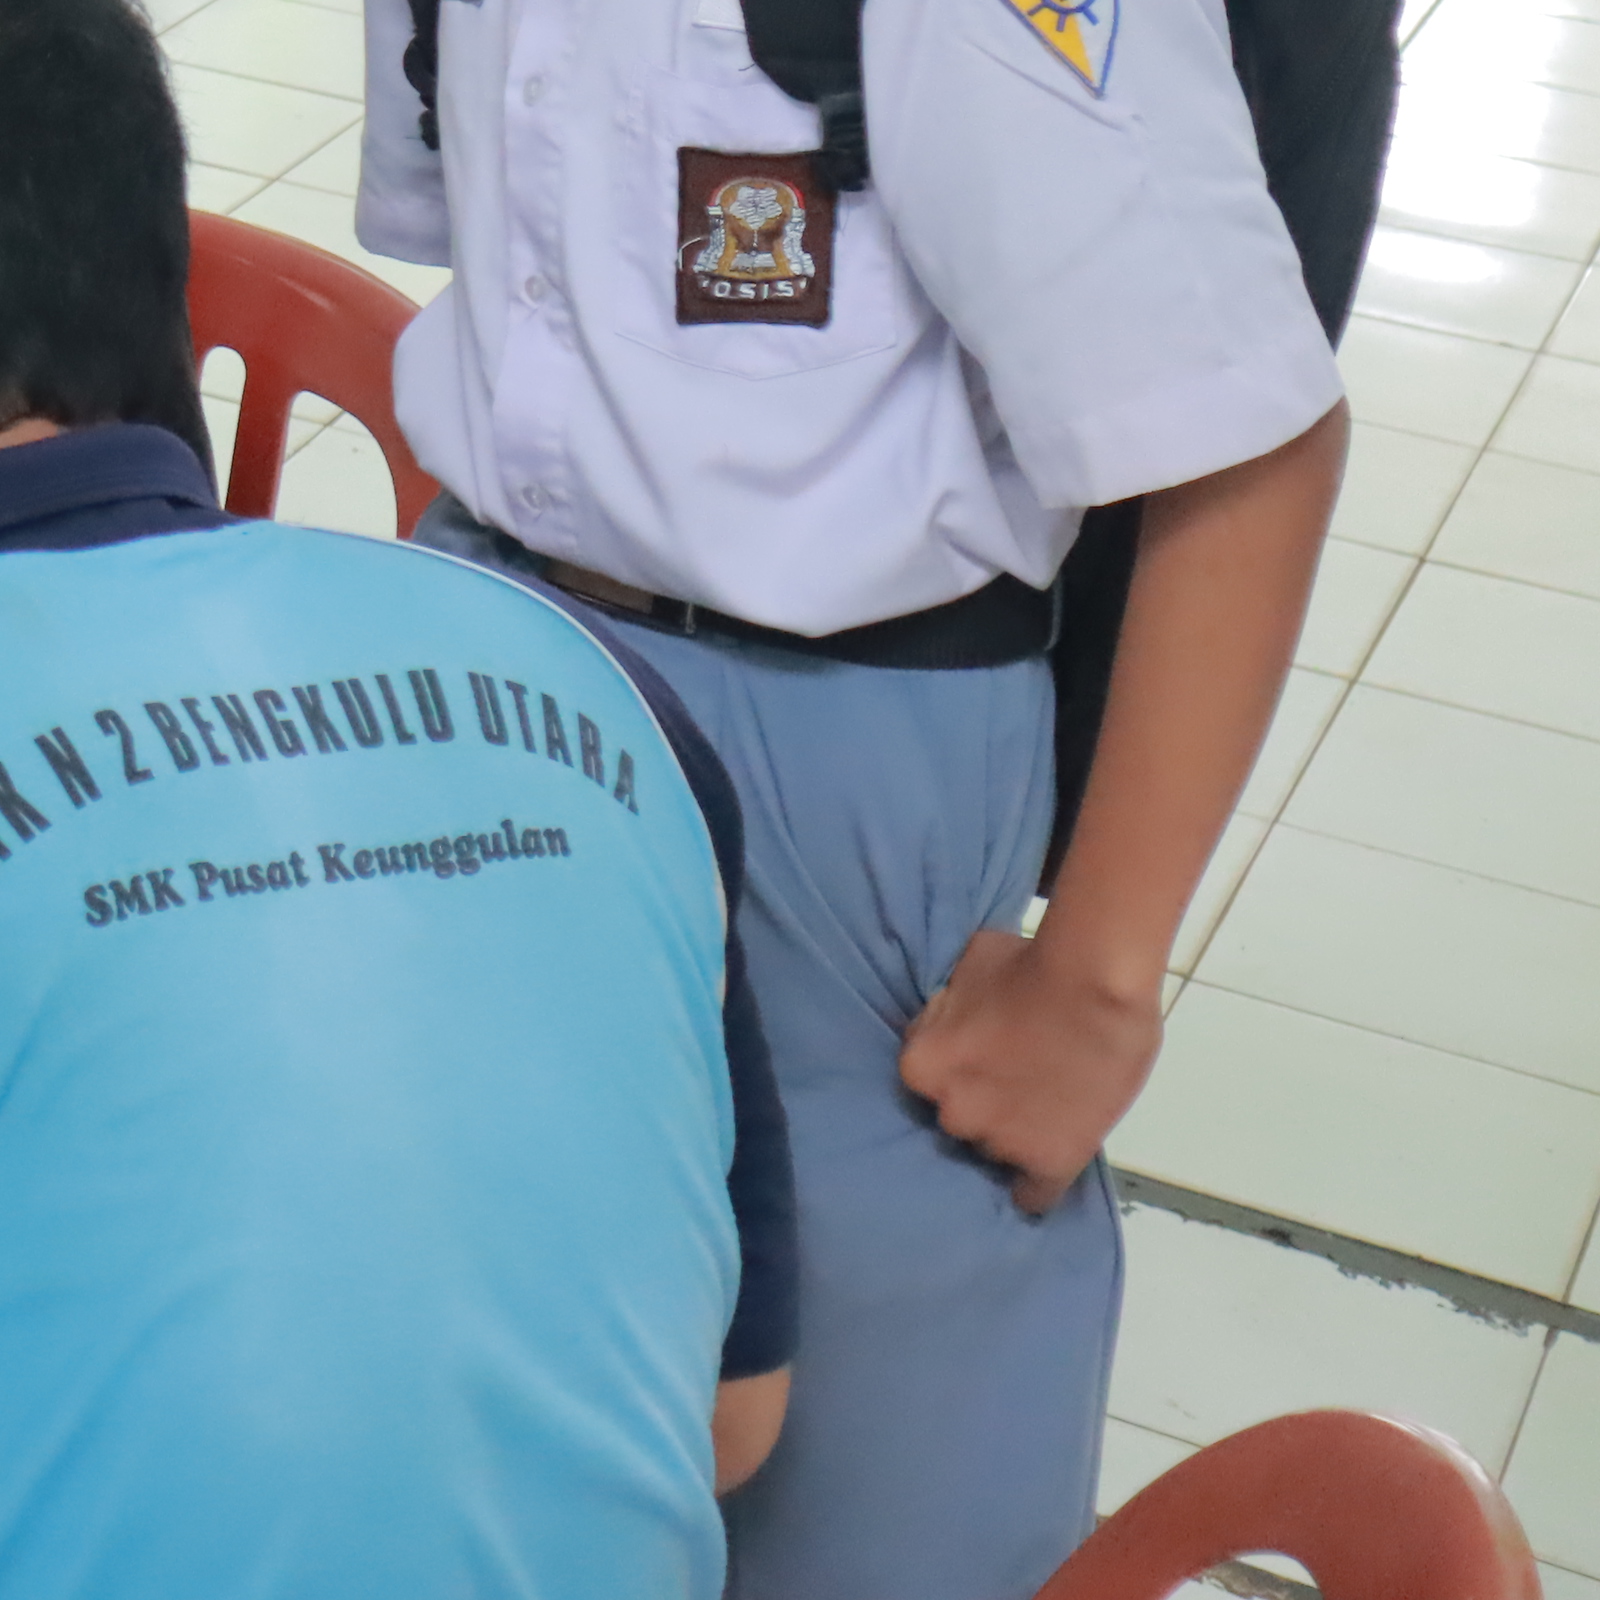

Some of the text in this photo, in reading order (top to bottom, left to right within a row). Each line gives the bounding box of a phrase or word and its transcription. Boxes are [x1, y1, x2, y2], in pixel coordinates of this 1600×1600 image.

[714, 280, 795, 300] OSIS
[33, 725, 103, 811] N
[94, 708, 155, 787] 2
[143, 667, 457, 774] BENGKULU
[466, 669, 640, 816] UTARA
[83, 818, 573, 929] SMK Pusat Keunggulan
